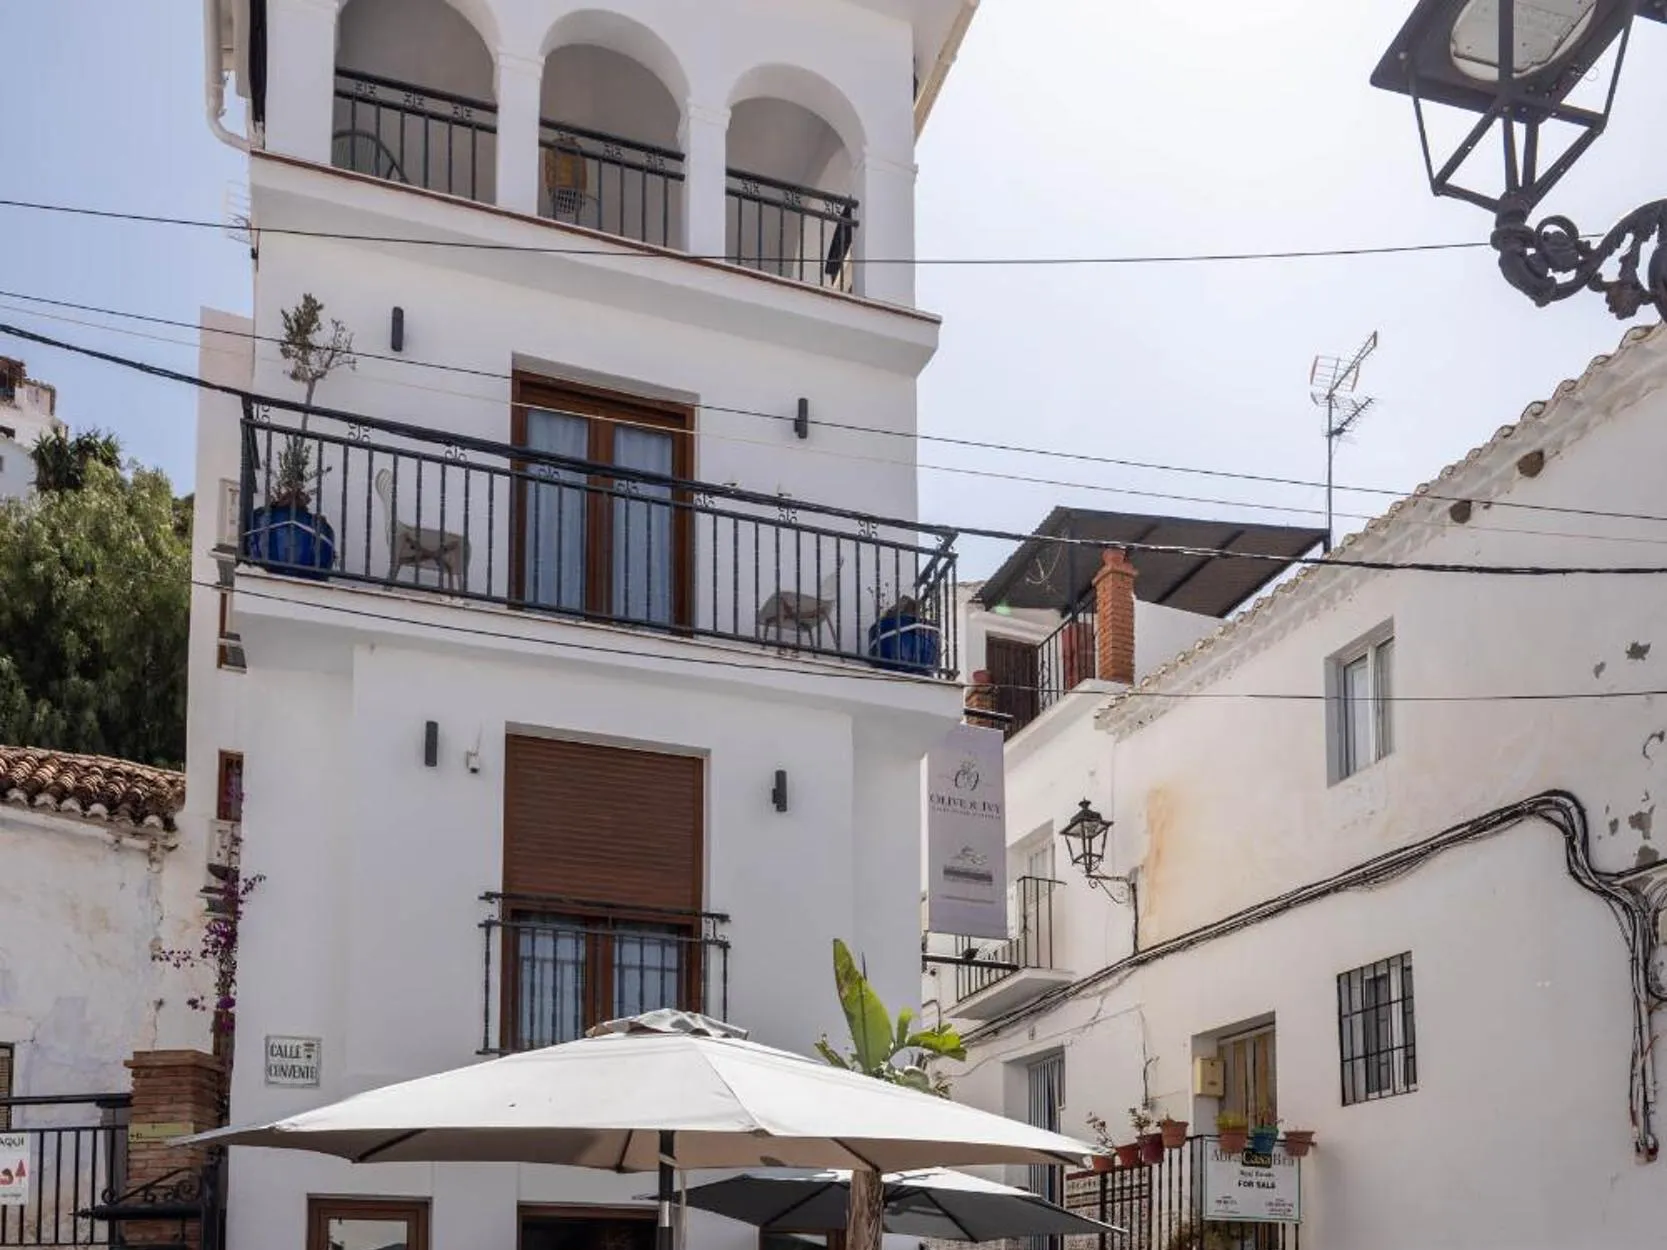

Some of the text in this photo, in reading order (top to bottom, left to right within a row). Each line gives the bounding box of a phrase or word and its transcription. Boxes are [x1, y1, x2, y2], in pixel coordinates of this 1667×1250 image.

[929, 793, 966, 809] OLIVE
[982, 800, 1000, 815] IVY
[270, 1042, 302, 1059] CALLE
[268, 1063, 319, 1080] CONVENTO
[1238, 1180, 1276, 1190] FOR SALE
